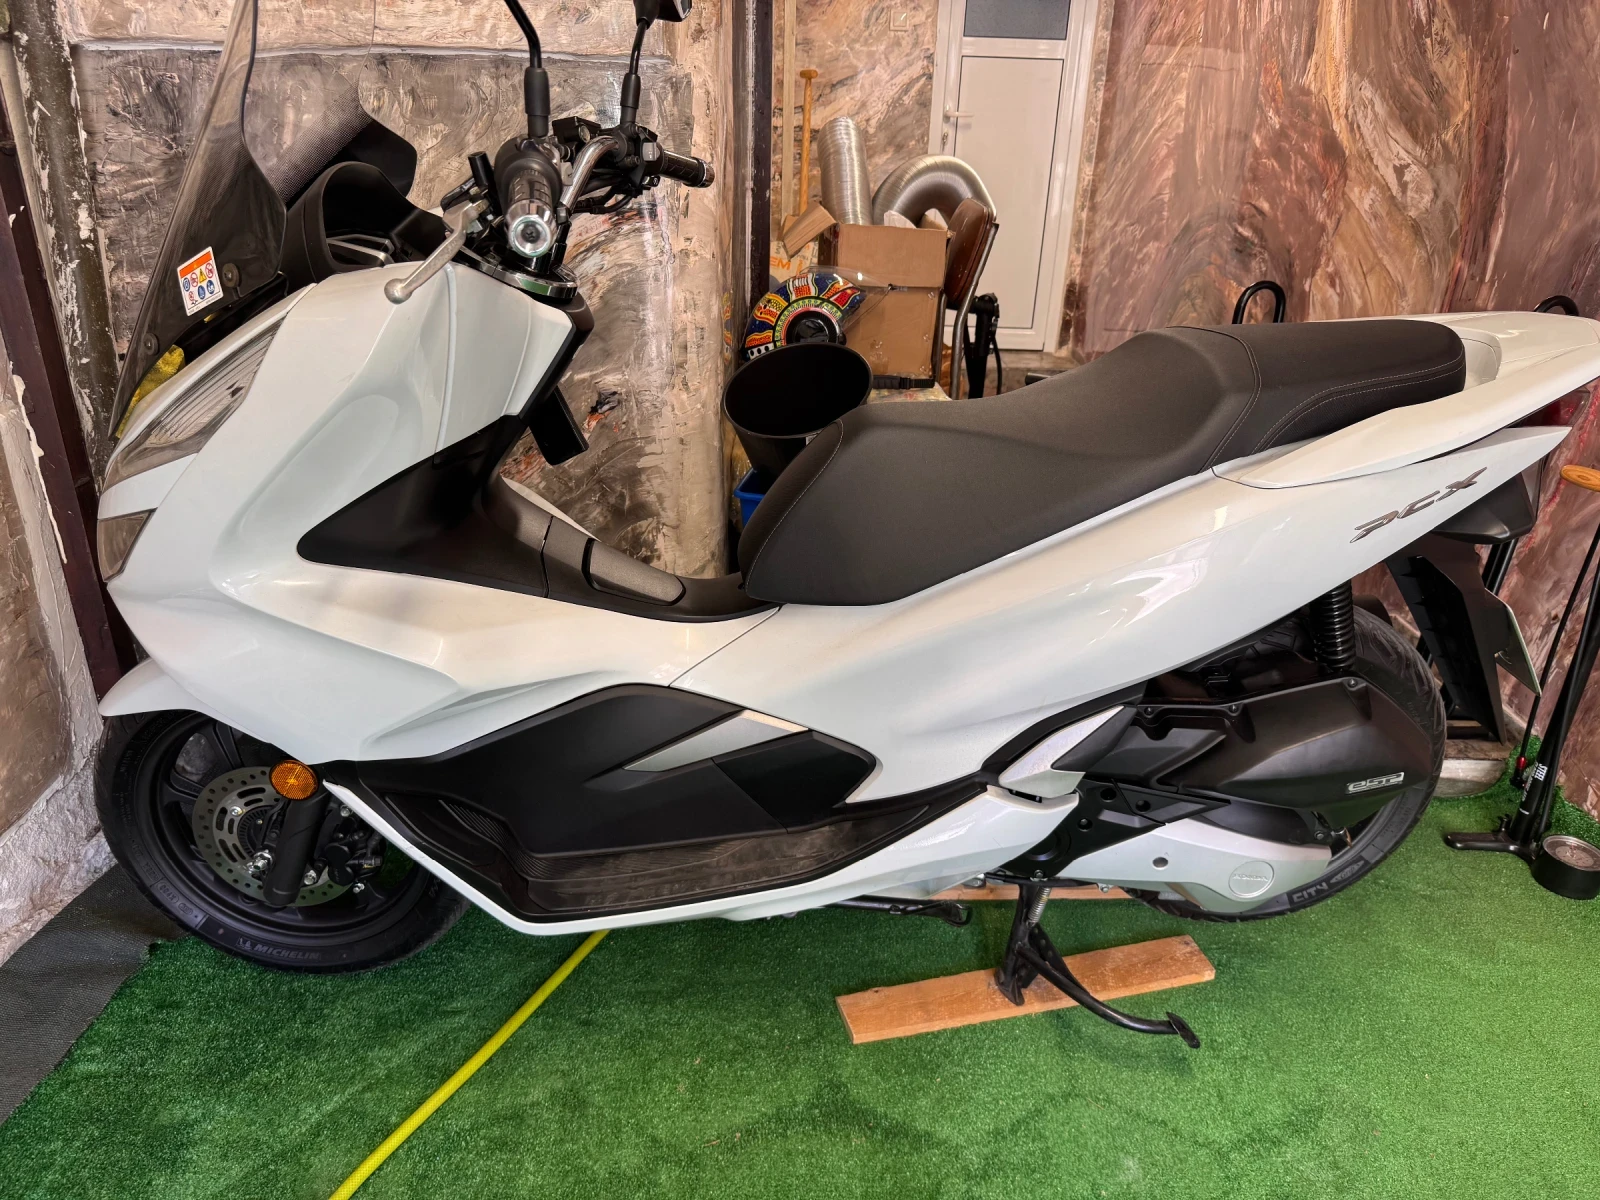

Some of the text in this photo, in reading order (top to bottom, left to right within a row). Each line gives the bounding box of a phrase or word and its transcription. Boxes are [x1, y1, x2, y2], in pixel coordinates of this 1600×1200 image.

[1350, 466, 1487, 543] PCX
[1292, 881, 1329, 903] CITY
[254, 944, 320, 959] MICHELIN
